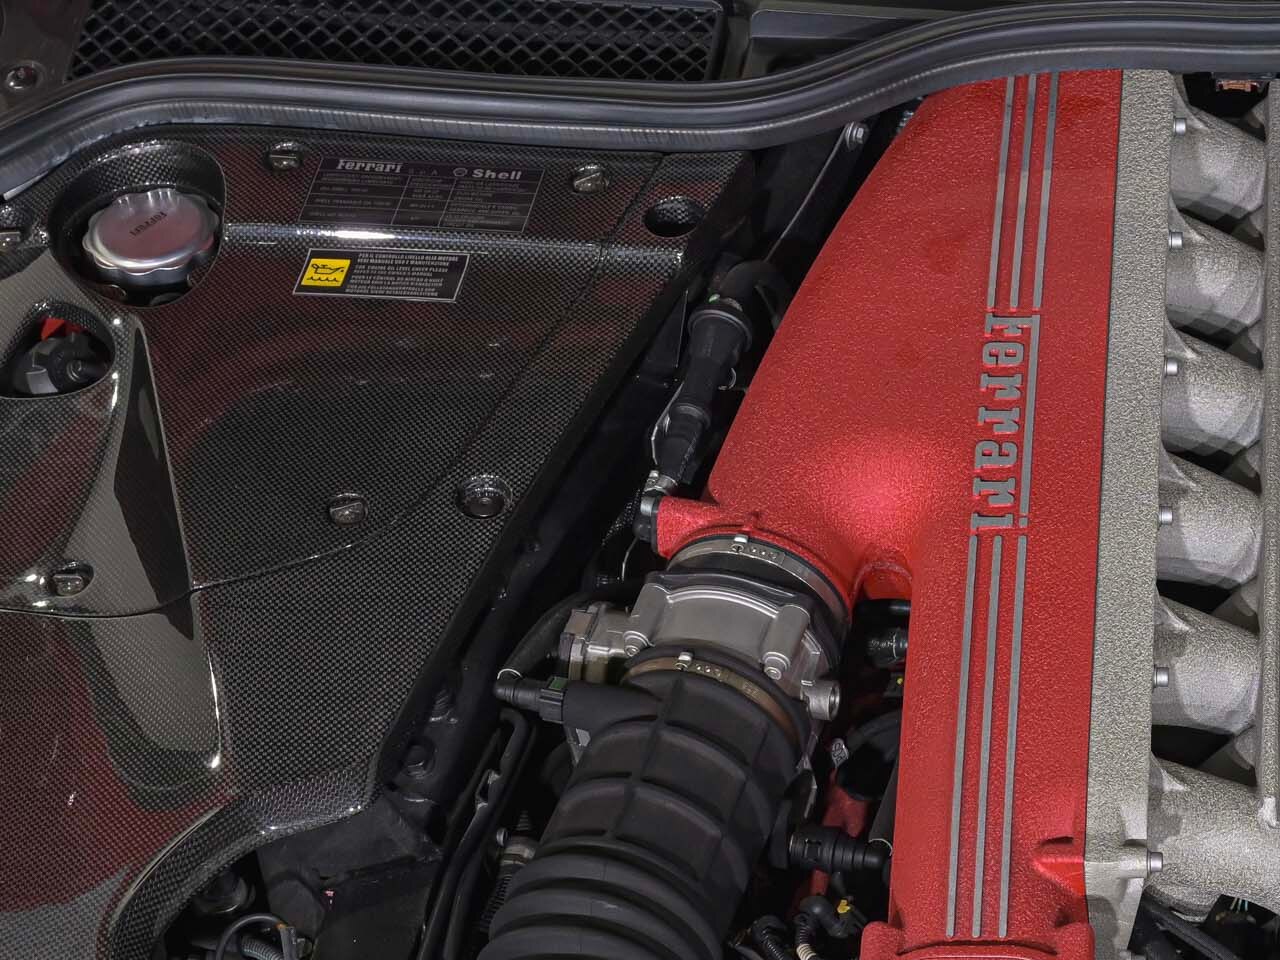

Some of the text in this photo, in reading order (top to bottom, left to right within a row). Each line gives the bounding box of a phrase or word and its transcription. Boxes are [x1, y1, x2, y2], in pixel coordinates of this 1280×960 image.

[336, 160, 402, 173] Ferrari
[472, 168, 522, 180] Shell
[970, 313, 1040, 532] Ferrari
